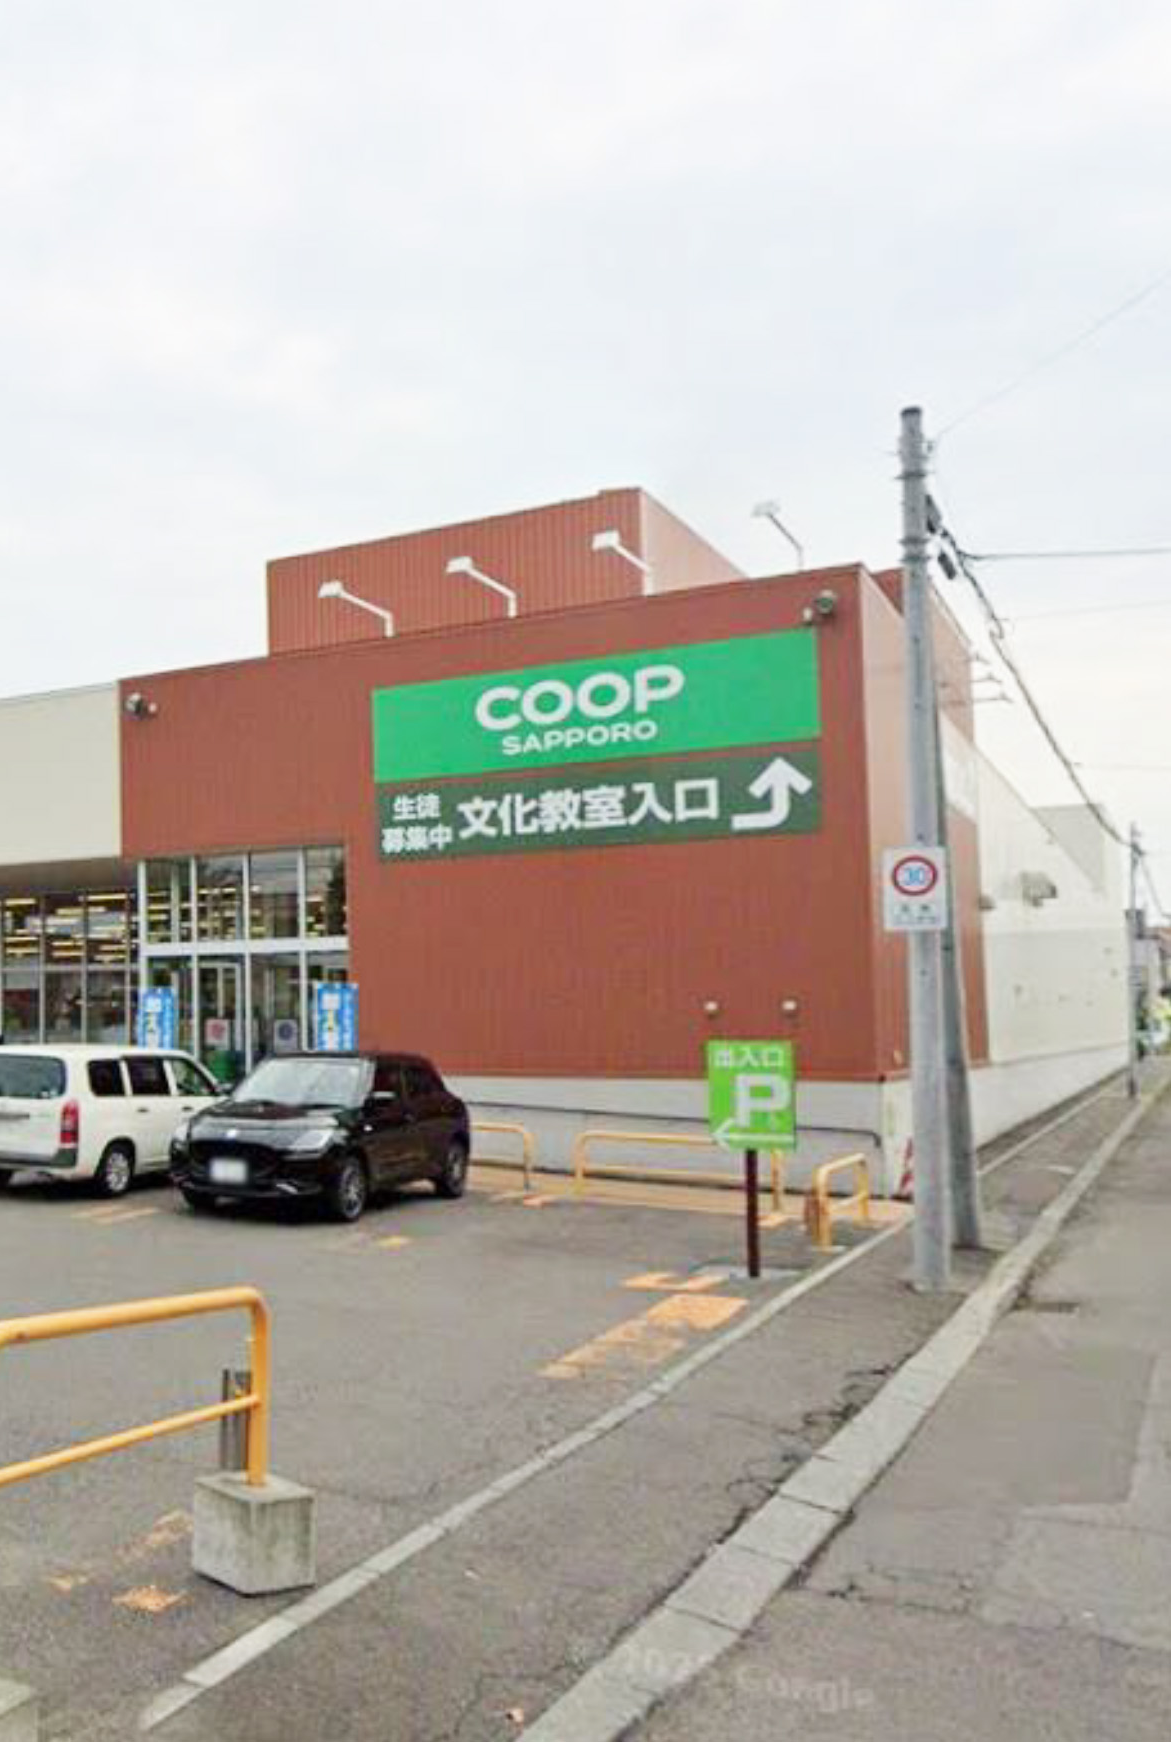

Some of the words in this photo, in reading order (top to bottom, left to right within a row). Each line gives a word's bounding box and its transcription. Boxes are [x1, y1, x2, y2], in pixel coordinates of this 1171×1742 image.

[475, 664, 684, 731] COOP
[502, 719, 658, 756] SAPPORO
[456, 778, 720, 840] 文化教室入口
[713, 1045, 785, 1068] 出入口
[734, 1074, 791, 1127] P
